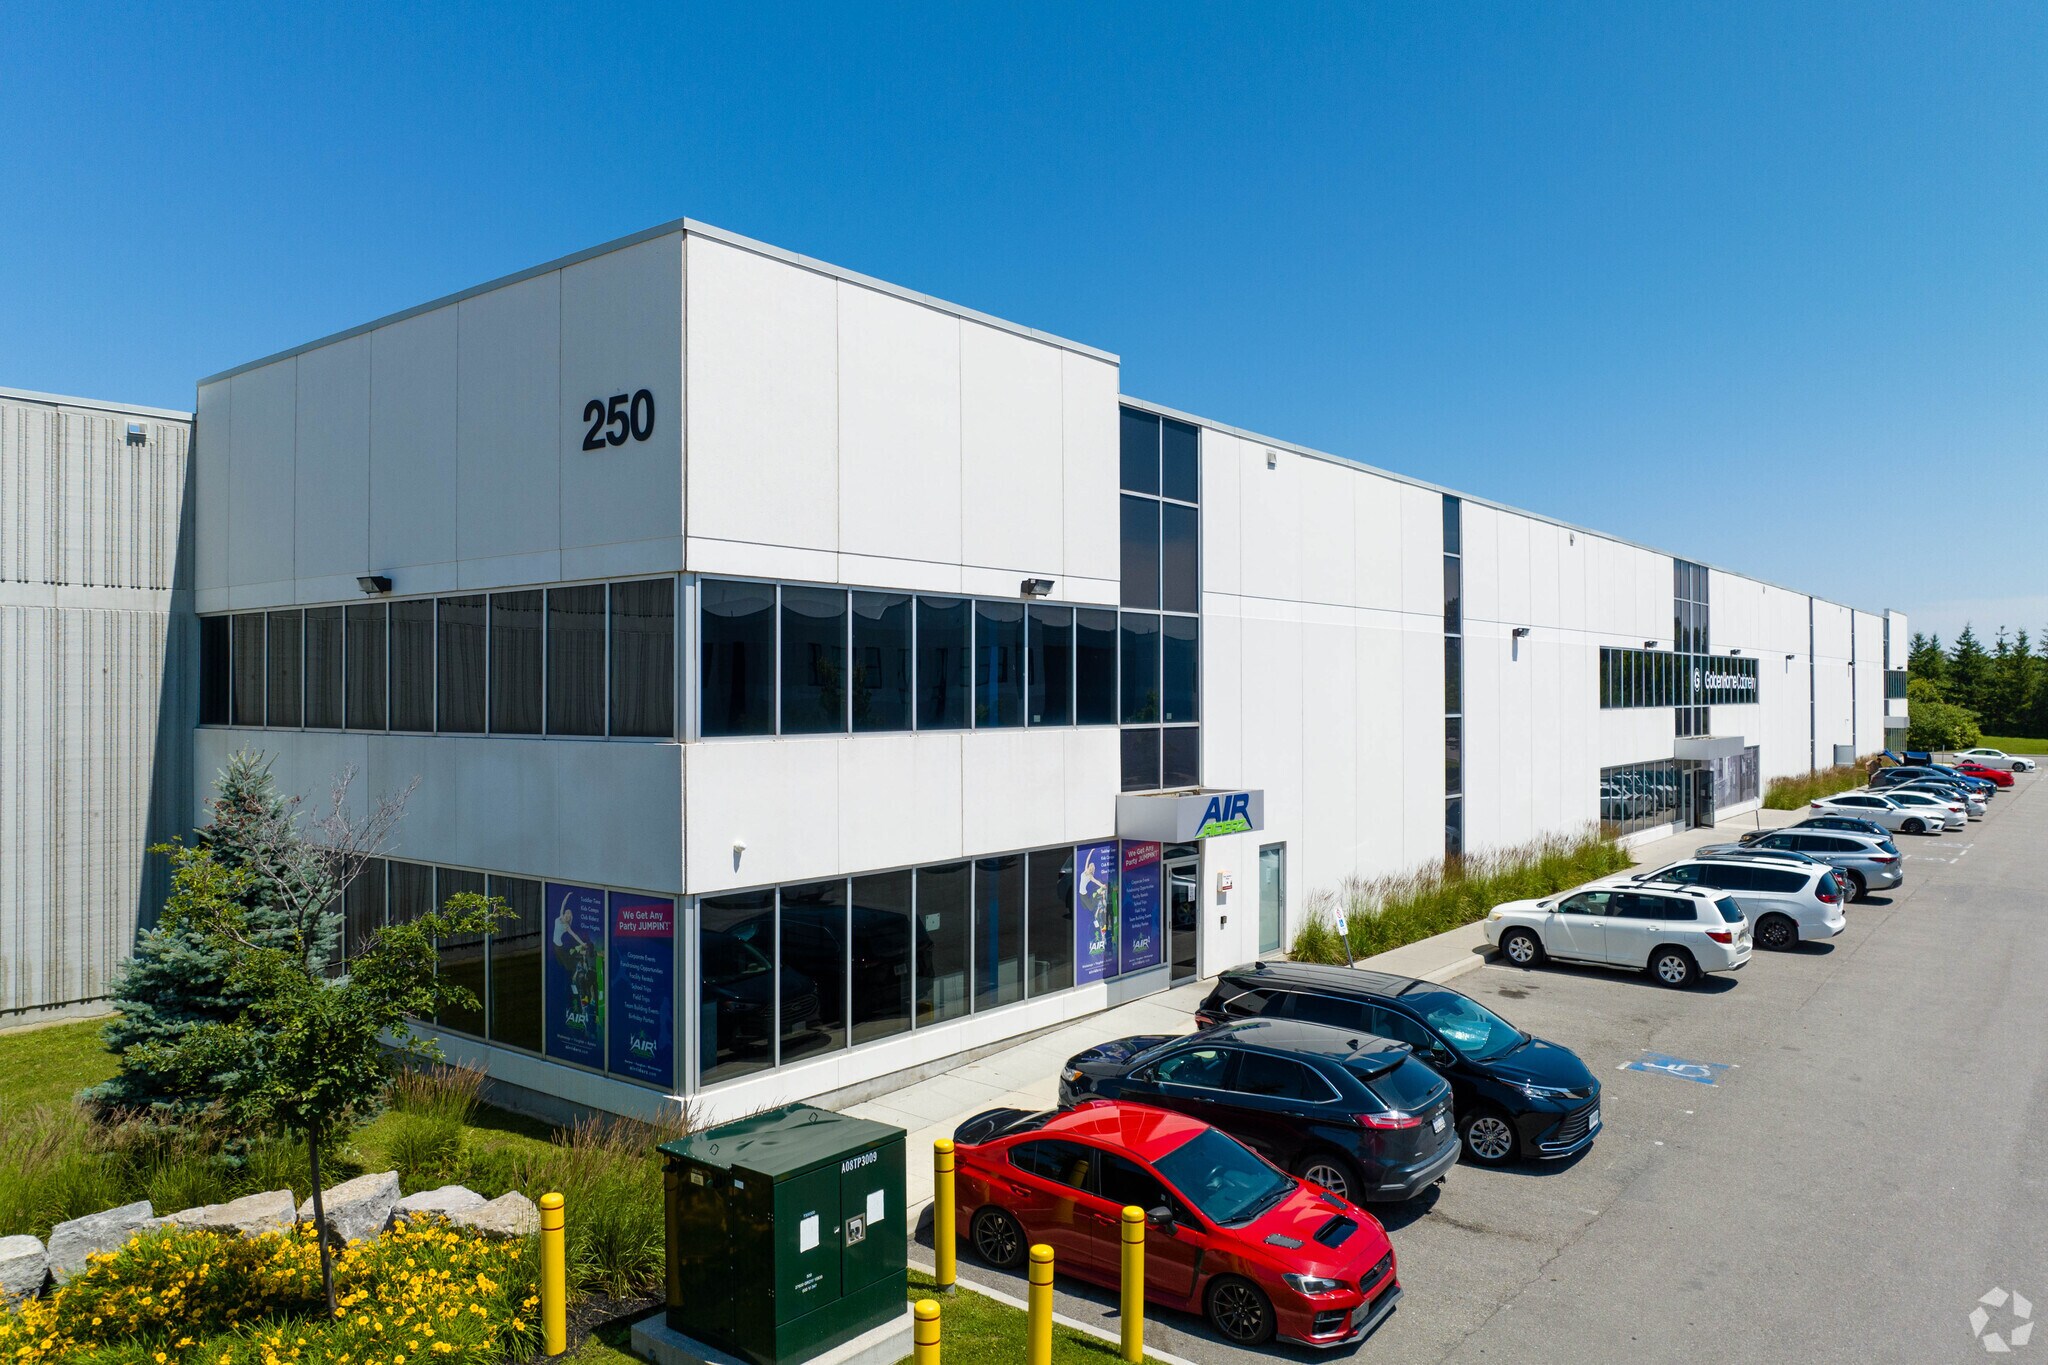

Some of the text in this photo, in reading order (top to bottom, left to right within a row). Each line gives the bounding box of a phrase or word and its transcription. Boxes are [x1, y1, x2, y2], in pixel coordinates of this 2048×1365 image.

[583, 389, 655, 451] 250
[1195, 793, 1253, 837] AIR
[622, 910, 664, 921] We Get Any
[619, 921, 637, 932] Party
[565, 1012, 587, 1028] AIR
[630, 1038, 655, 1057] AIR
[841, 1151, 878, 1174] A08TP3009
